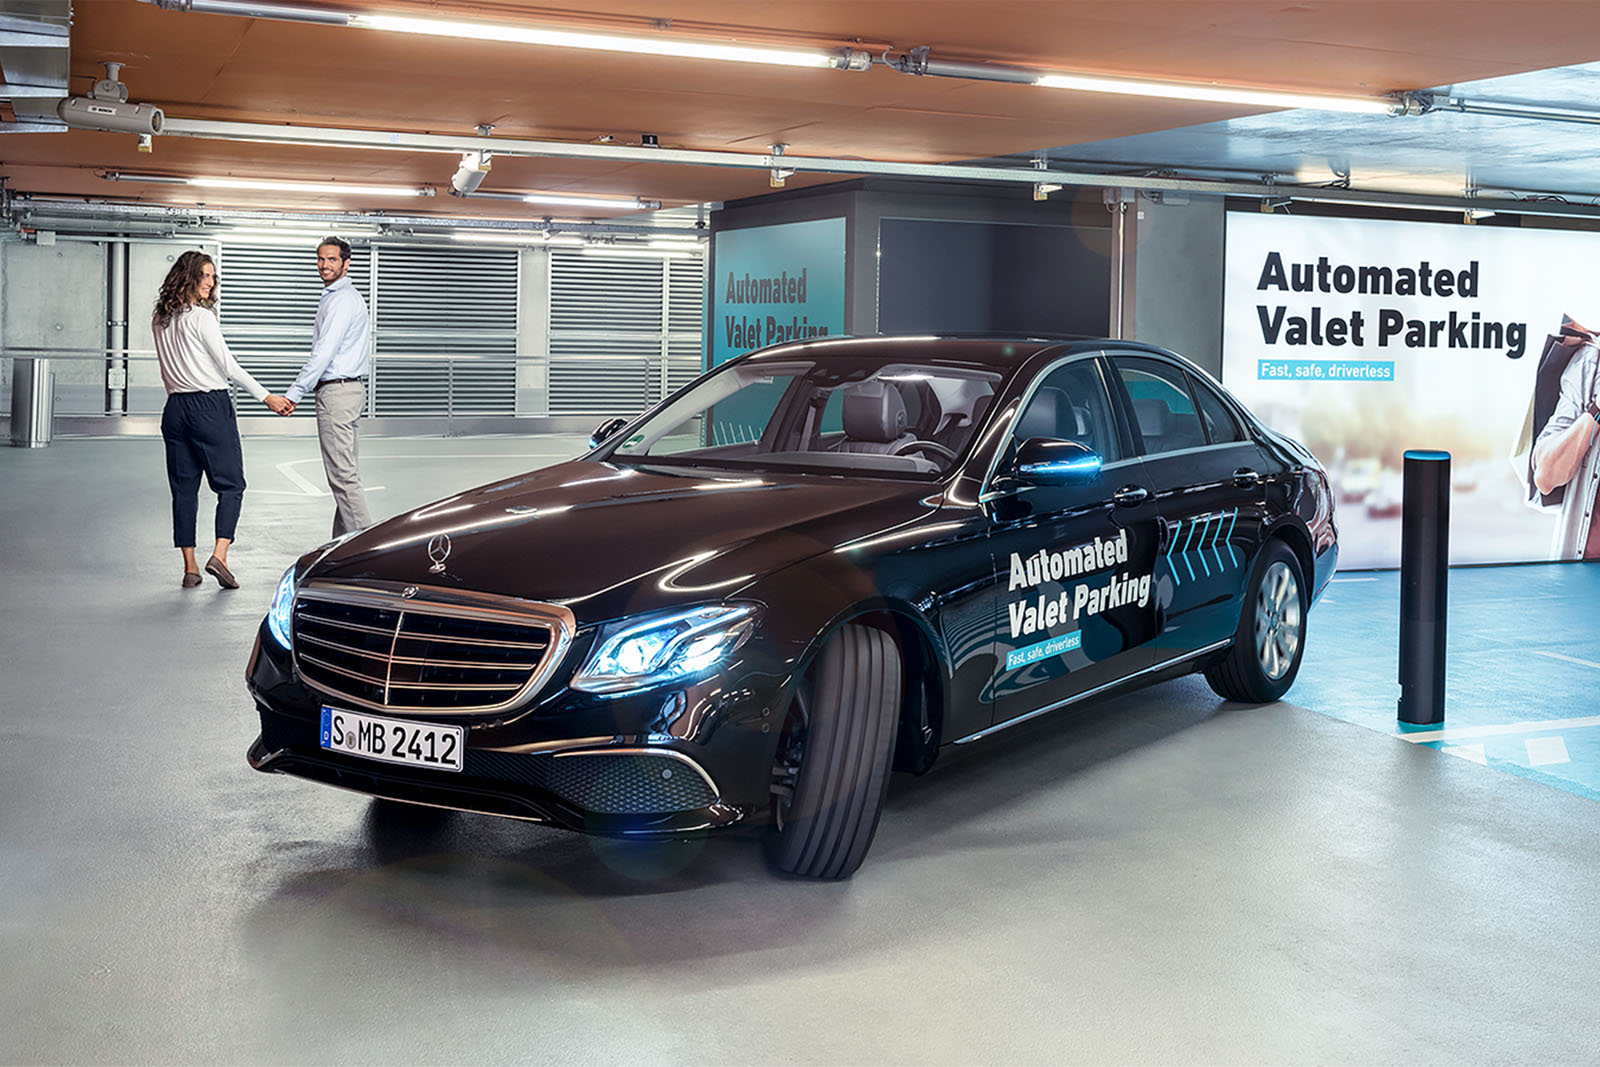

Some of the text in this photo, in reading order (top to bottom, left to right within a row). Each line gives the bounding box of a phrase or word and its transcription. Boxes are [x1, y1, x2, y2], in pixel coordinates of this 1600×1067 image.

[725, 268, 807, 304] Automated
[1256, 251, 1479, 298] Automated
[725, 316, 762, 349] Valet
[1256, 305, 1527, 359] Valet Parking
[1261, 362, 1391, 379] Fast, safe, driverless
[1008, 528, 1128, 592] Automated
[1008, 571, 1151, 639] Valet Parking
[1008, 636, 1079, 667] Fast, safe, driverless
[333, 715, 456, 764] S MB 2412
